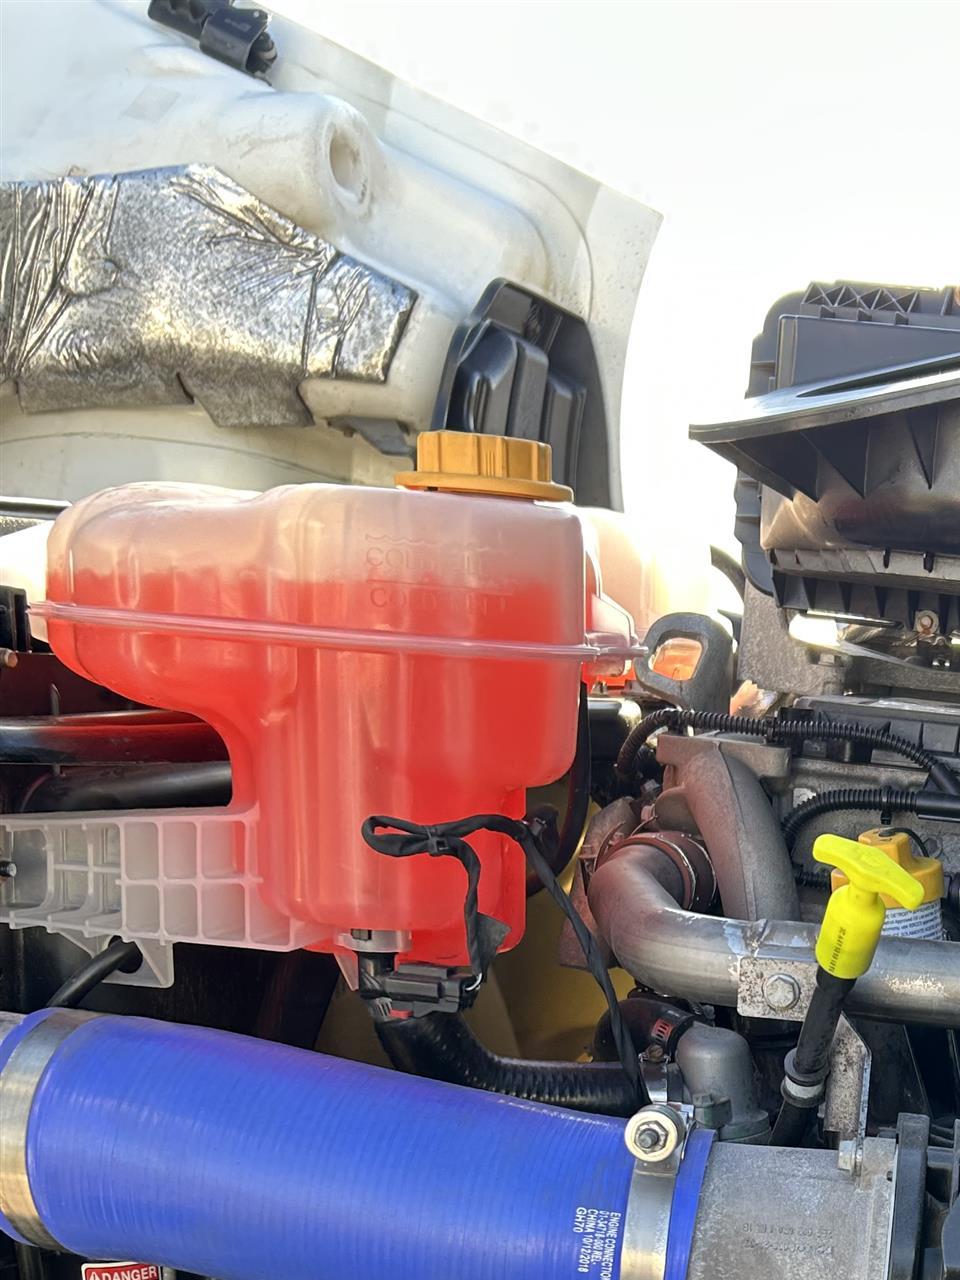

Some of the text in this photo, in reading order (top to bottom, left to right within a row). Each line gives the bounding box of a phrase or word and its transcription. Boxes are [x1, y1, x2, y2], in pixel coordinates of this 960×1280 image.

[573, 1207, 587, 1233] GH70
[606, 1212, 621, 1238] ENGINE
[578, 1209, 598, 1273] CHINA 10/12/2018
